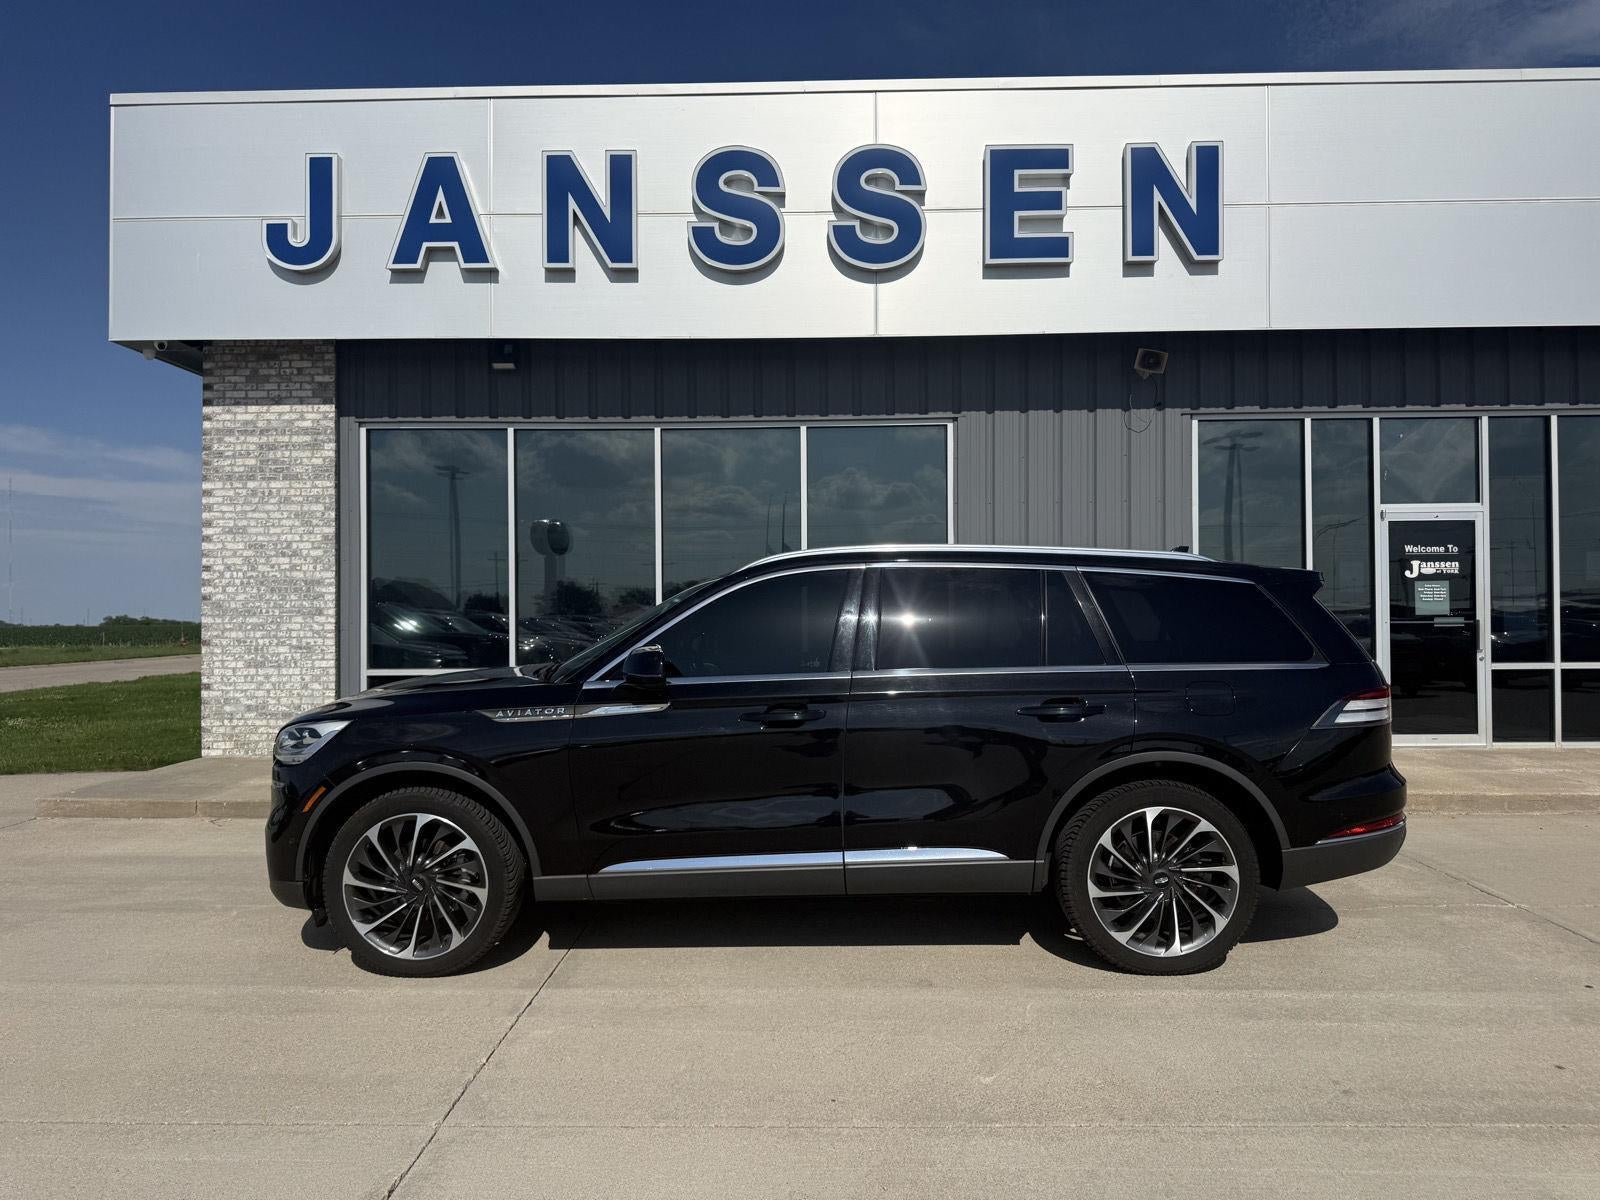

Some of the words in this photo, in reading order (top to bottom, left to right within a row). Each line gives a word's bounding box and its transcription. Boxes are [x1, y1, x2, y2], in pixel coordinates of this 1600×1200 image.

[262, 141, 1224, 273] JANSSEN
[1404, 544, 1445, 553] Welcome
[1447, 544, 1459, 553] To
[1404, 560, 1460, 578] Janssen
[495, 707, 566, 718] AVIATOR
